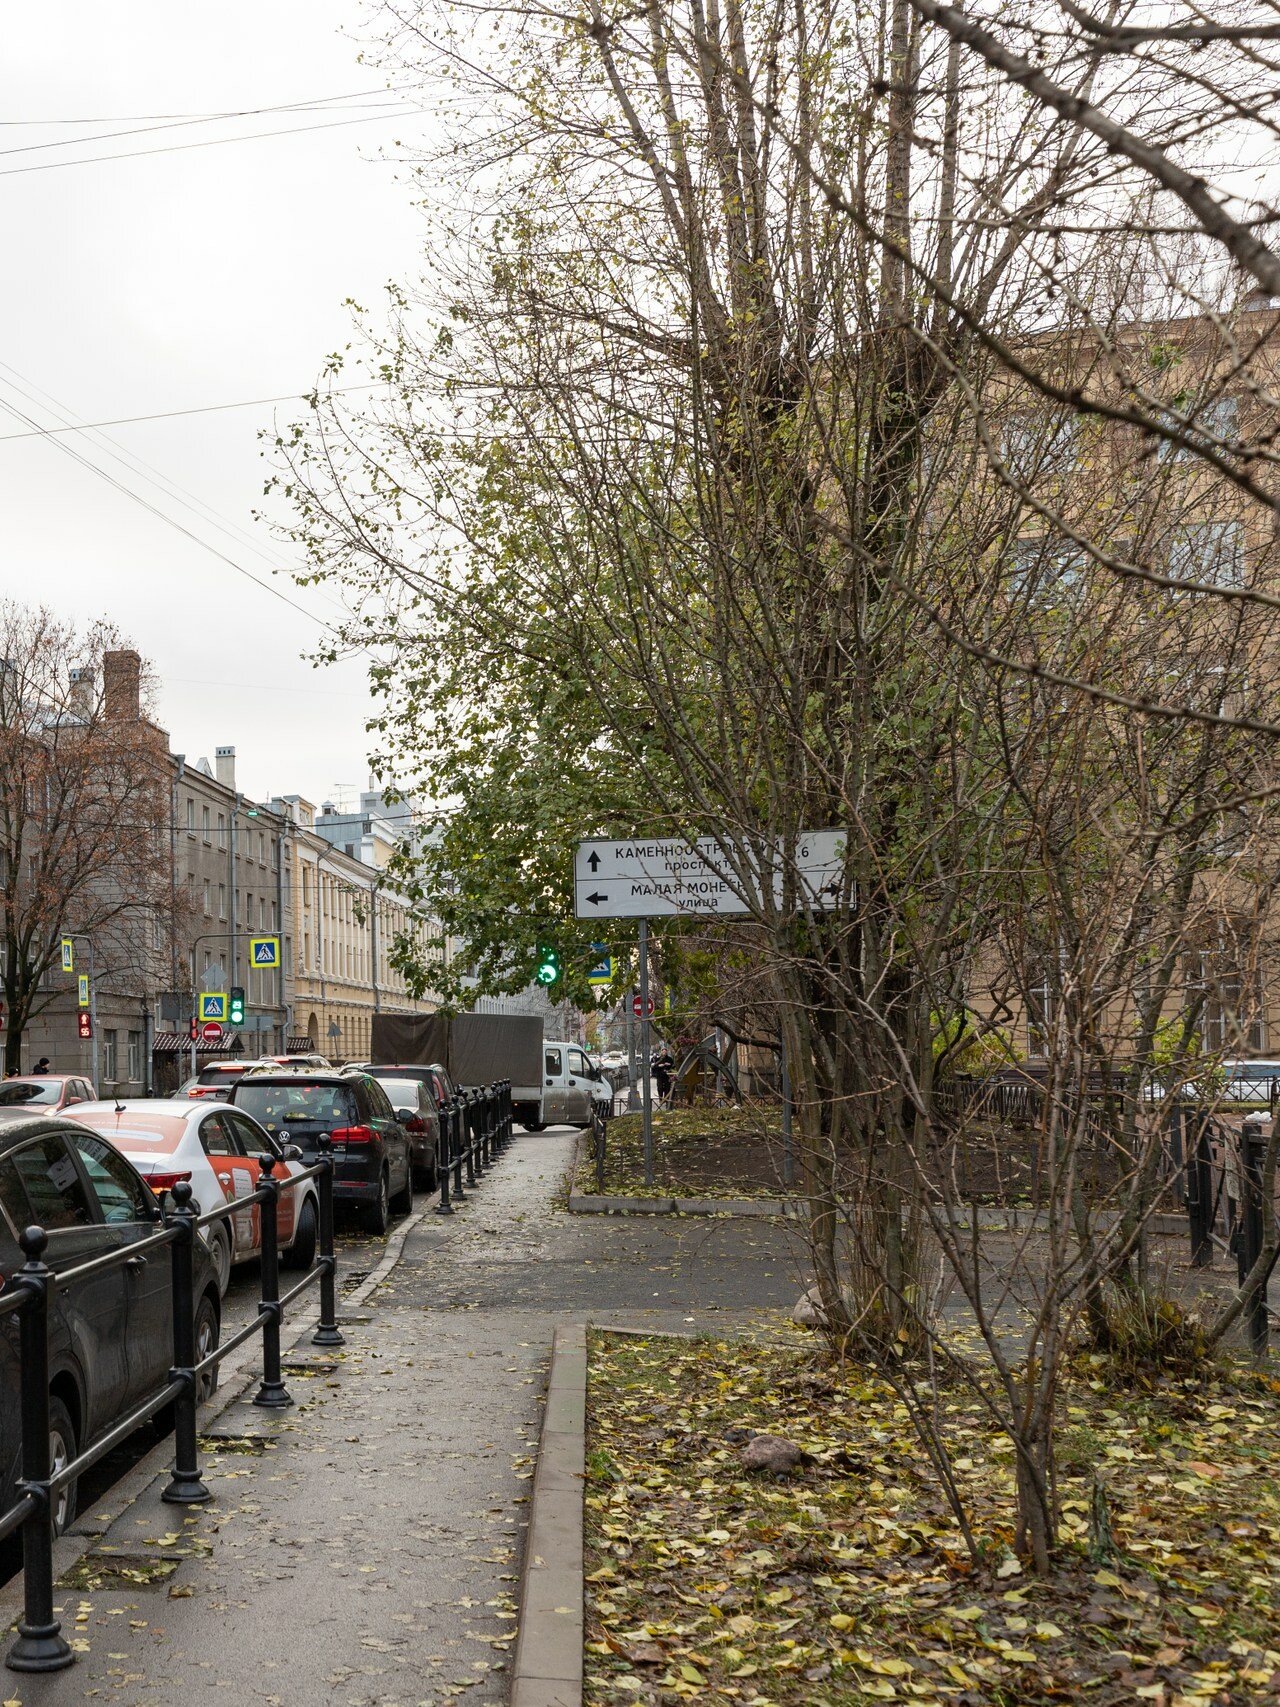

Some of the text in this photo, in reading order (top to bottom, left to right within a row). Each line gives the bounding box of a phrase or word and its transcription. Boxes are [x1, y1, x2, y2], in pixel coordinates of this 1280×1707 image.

[665, 859, 729, 873] проспкт
[631, 883, 682, 896] МАЛАЯ
[678, 897, 718, 909] улица
